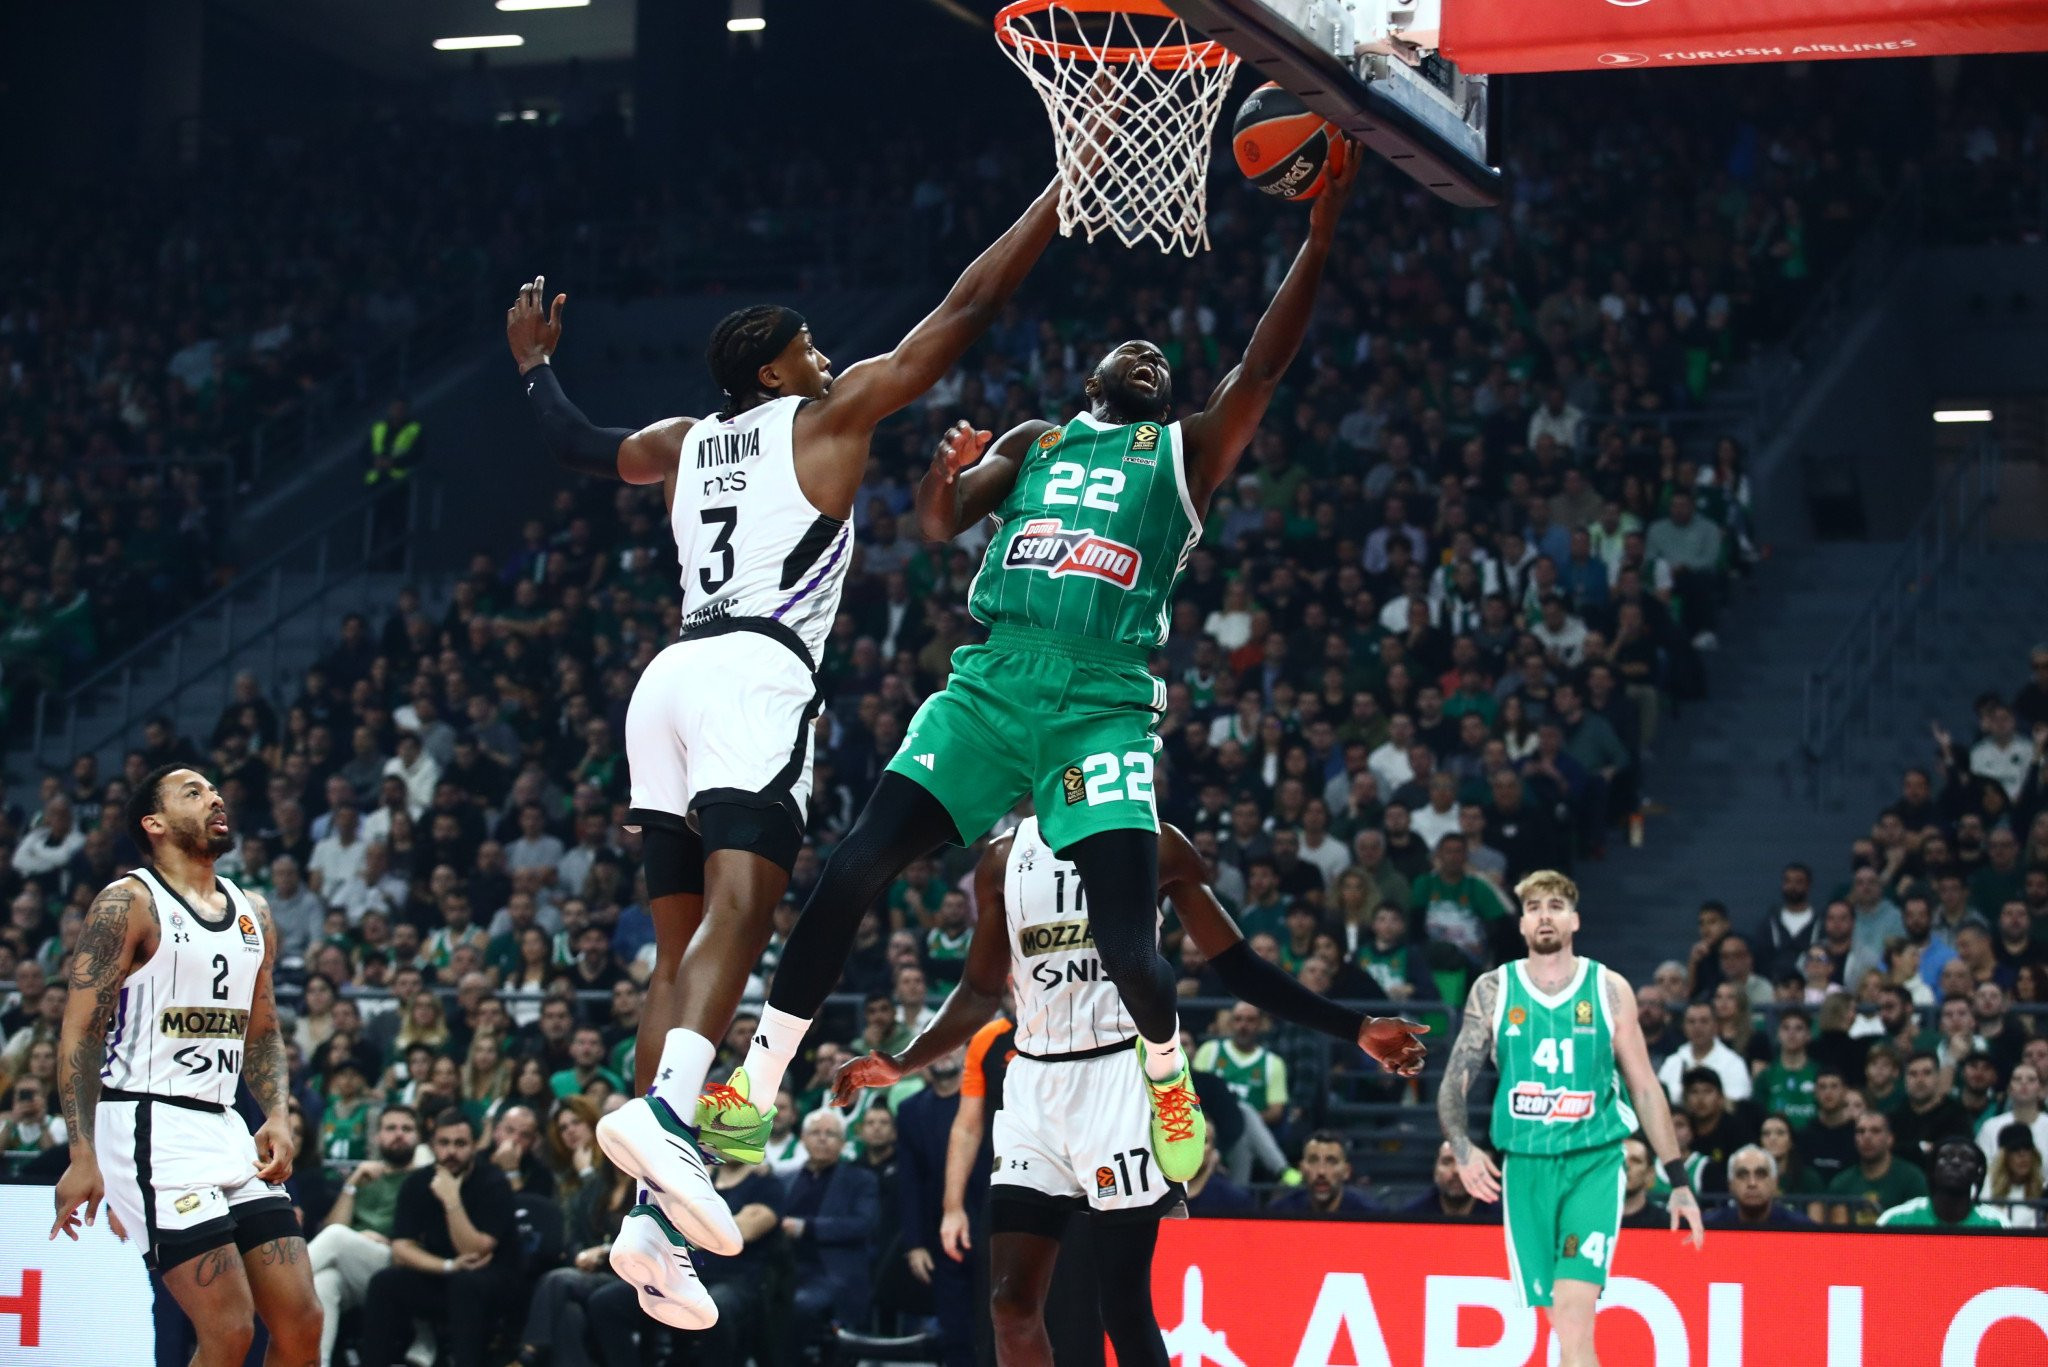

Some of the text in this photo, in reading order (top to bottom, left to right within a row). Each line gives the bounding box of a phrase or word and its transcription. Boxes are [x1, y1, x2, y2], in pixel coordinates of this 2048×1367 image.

[1659, 39, 1918, 61] TURKISH AIRLINES
[1258, 155, 1314, 195] SPALD
[1043, 461, 1126, 513] 22
[700, 506, 738, 595] 3
[1082, 751, 1154, 807] 22
[1054, 869, 1084, 914] 17
[212, 953, 229, 1000] 2
[1532, 1037, 1574, 1075] 41
[1113, 1147, 1151, 1197] 17
